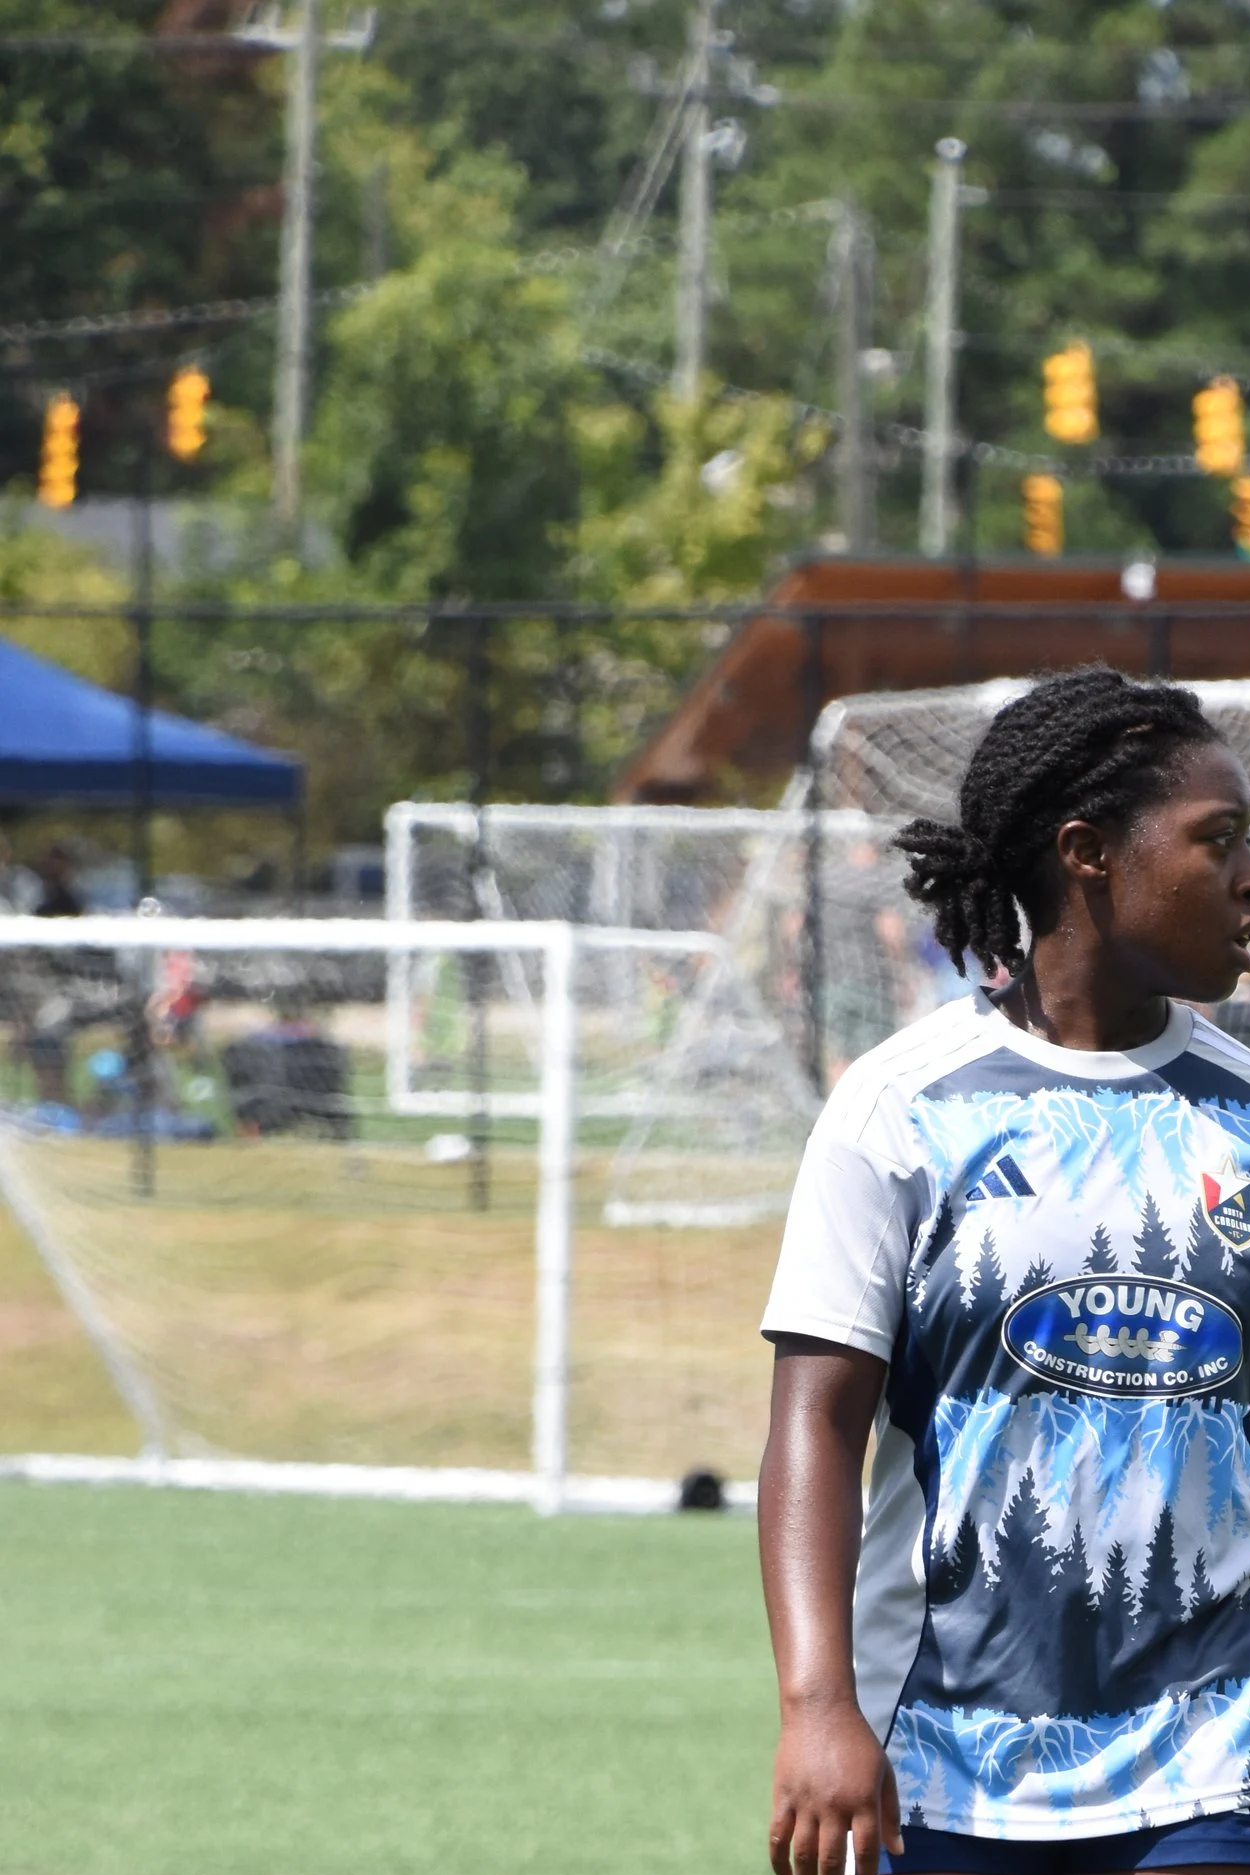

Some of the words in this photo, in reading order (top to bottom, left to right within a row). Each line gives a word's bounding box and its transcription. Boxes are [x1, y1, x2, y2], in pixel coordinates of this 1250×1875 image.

[1223, 1207, 1244, 1219] NORTH
[1058, 1285, 1205, 1332] YOUNG
[1024, 1340, 1158, 1386] CONSTRUCTION
[1163, 1370, 1194, 1386] CO.
[1199, 1356, 1229, 1378] INC
